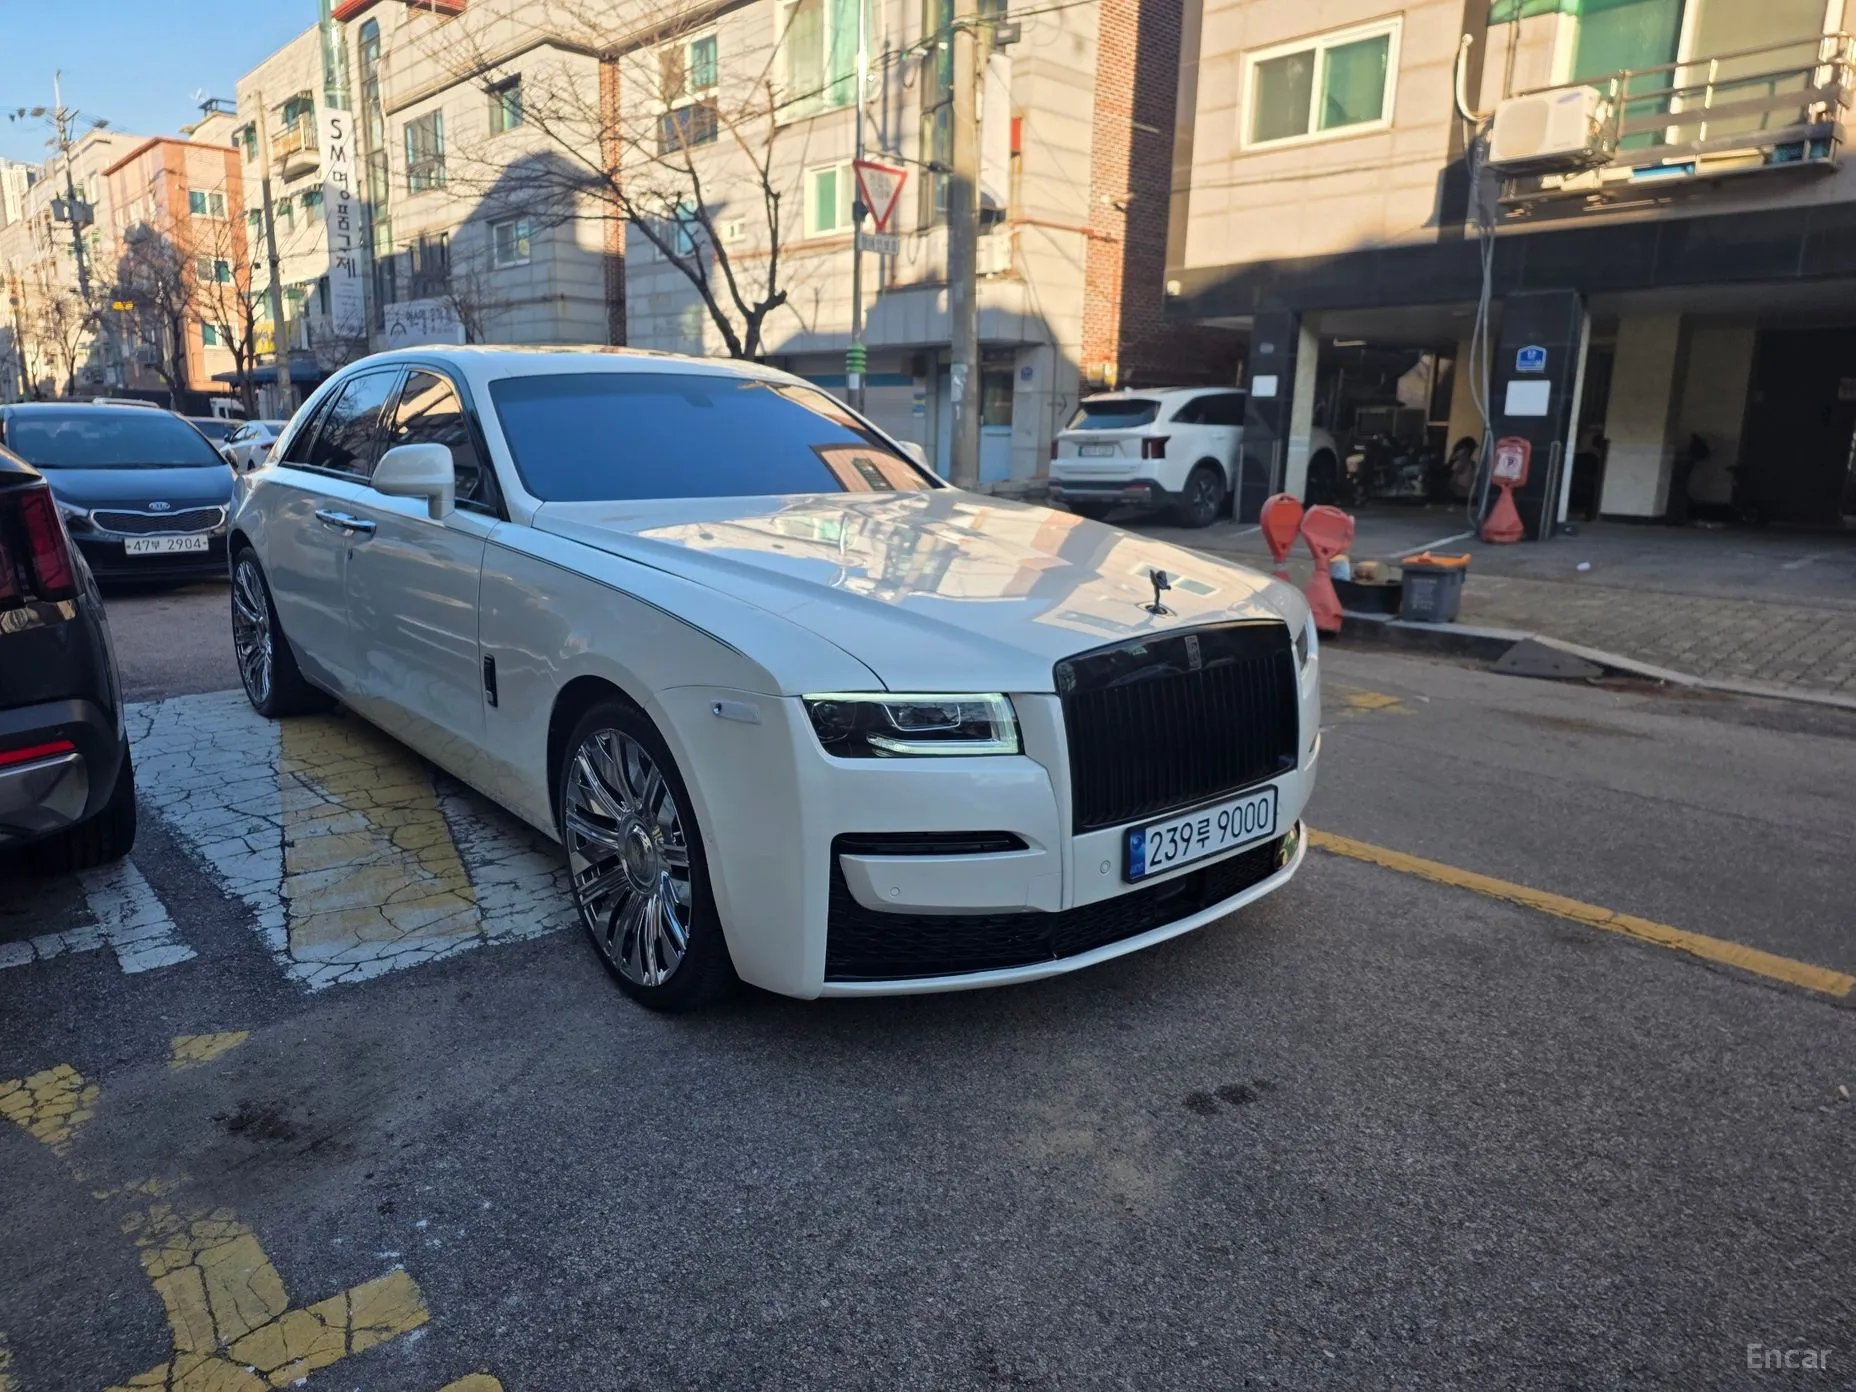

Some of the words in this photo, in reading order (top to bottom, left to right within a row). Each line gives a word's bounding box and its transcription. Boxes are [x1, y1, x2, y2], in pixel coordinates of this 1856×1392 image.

[167, 538, 201, 551] 2904
[1150, 817, 1211, 867] 239루
[1217, 798, 1269, 844] 9000
